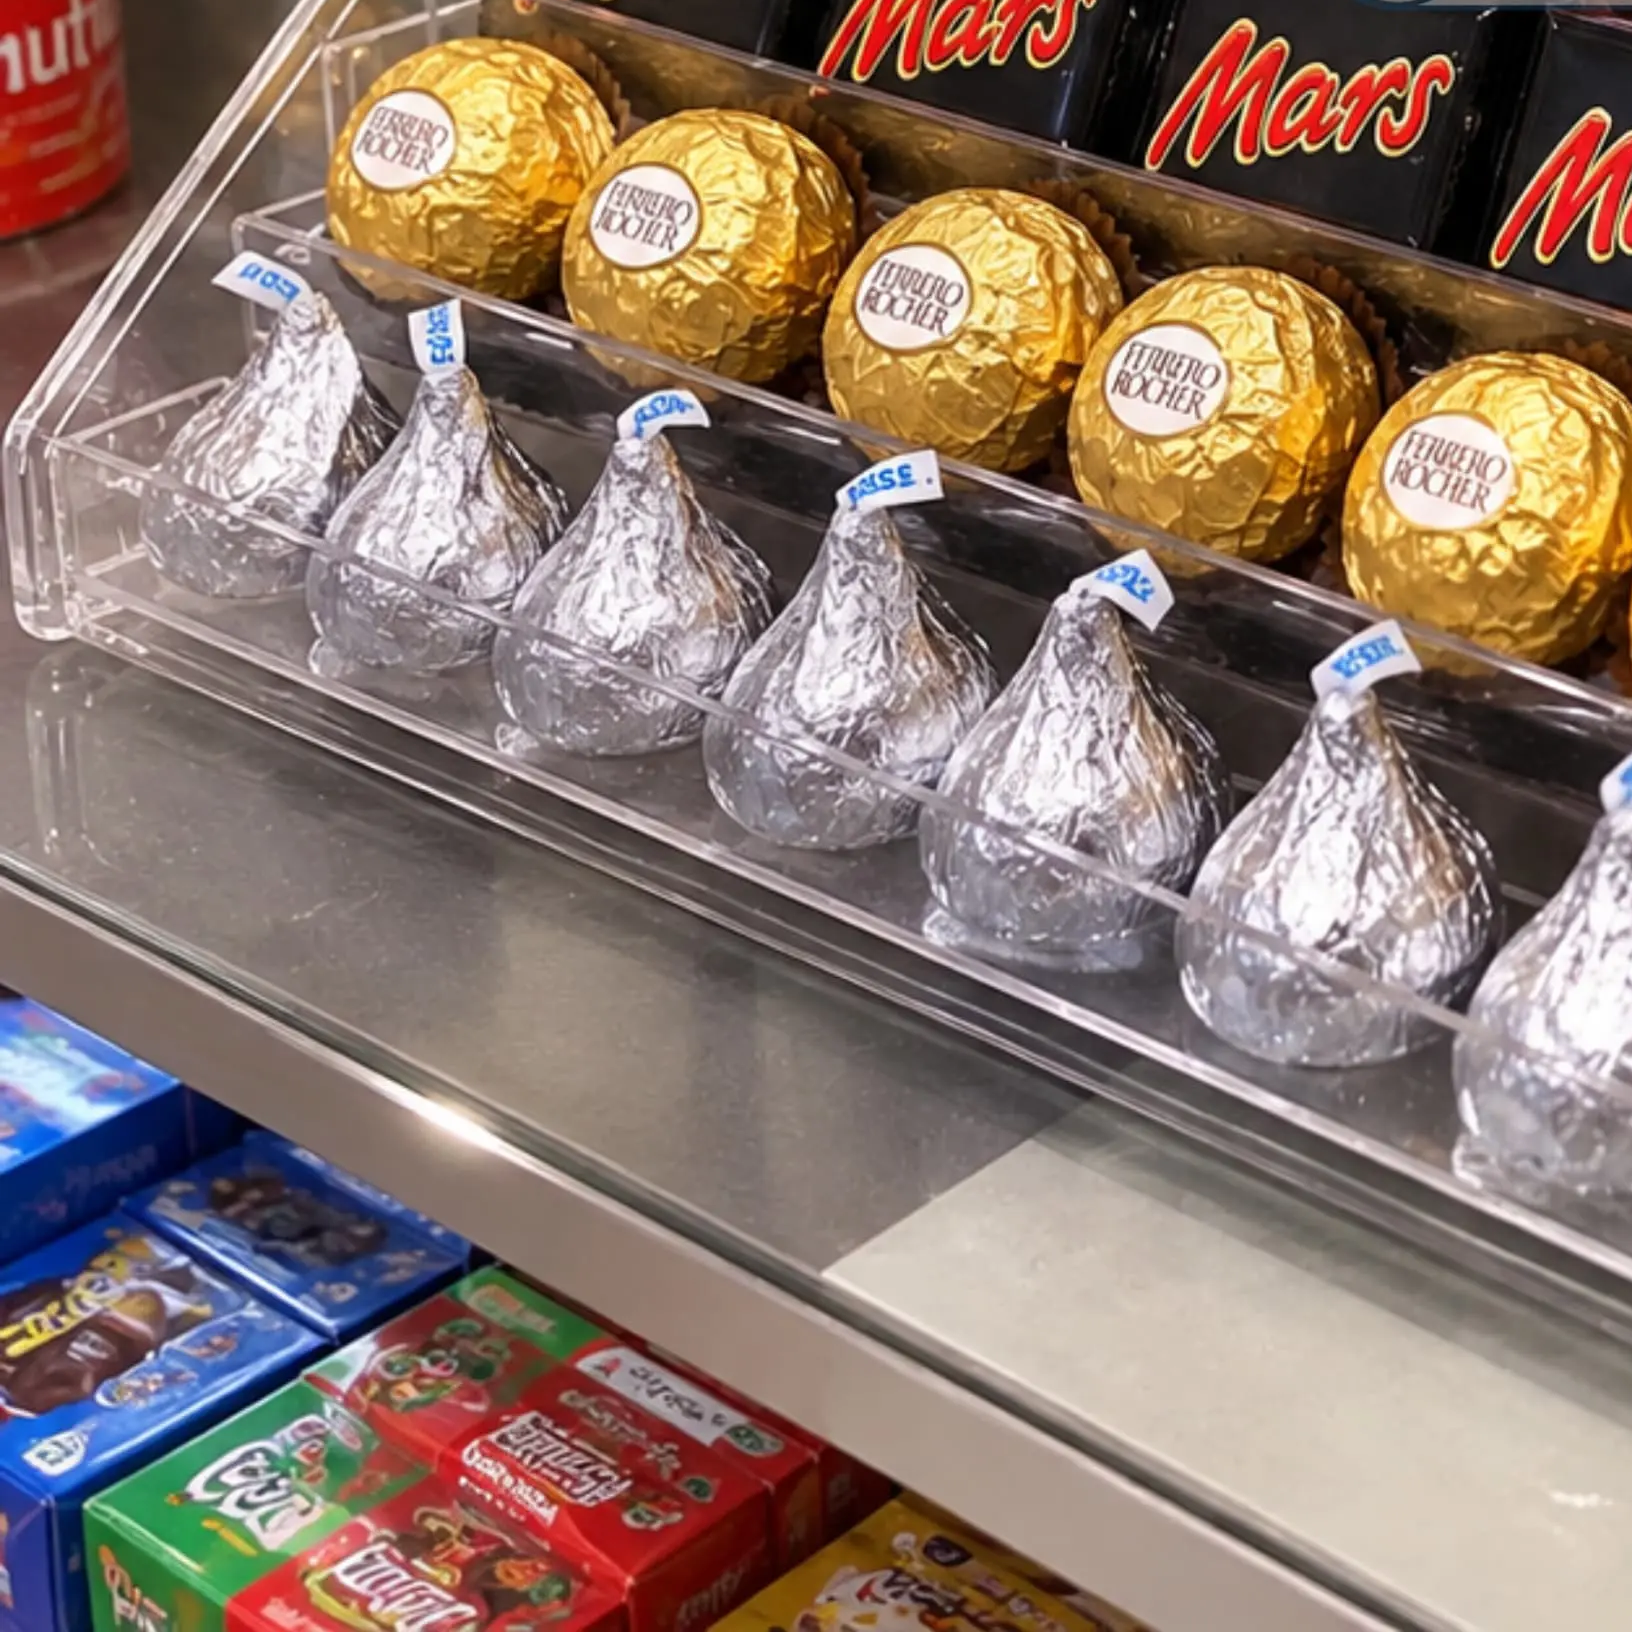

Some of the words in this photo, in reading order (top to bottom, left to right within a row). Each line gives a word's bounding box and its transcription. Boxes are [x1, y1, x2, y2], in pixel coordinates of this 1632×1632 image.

[1145, 18, 1454, 171] Mars
[872, 258, 964, 308] FERRERO
[860, 285, 950, 337] ROCHER
[1110, 370, 1207, 420] ROCHER
[1389, 457, 1491, 514] ROCHER
